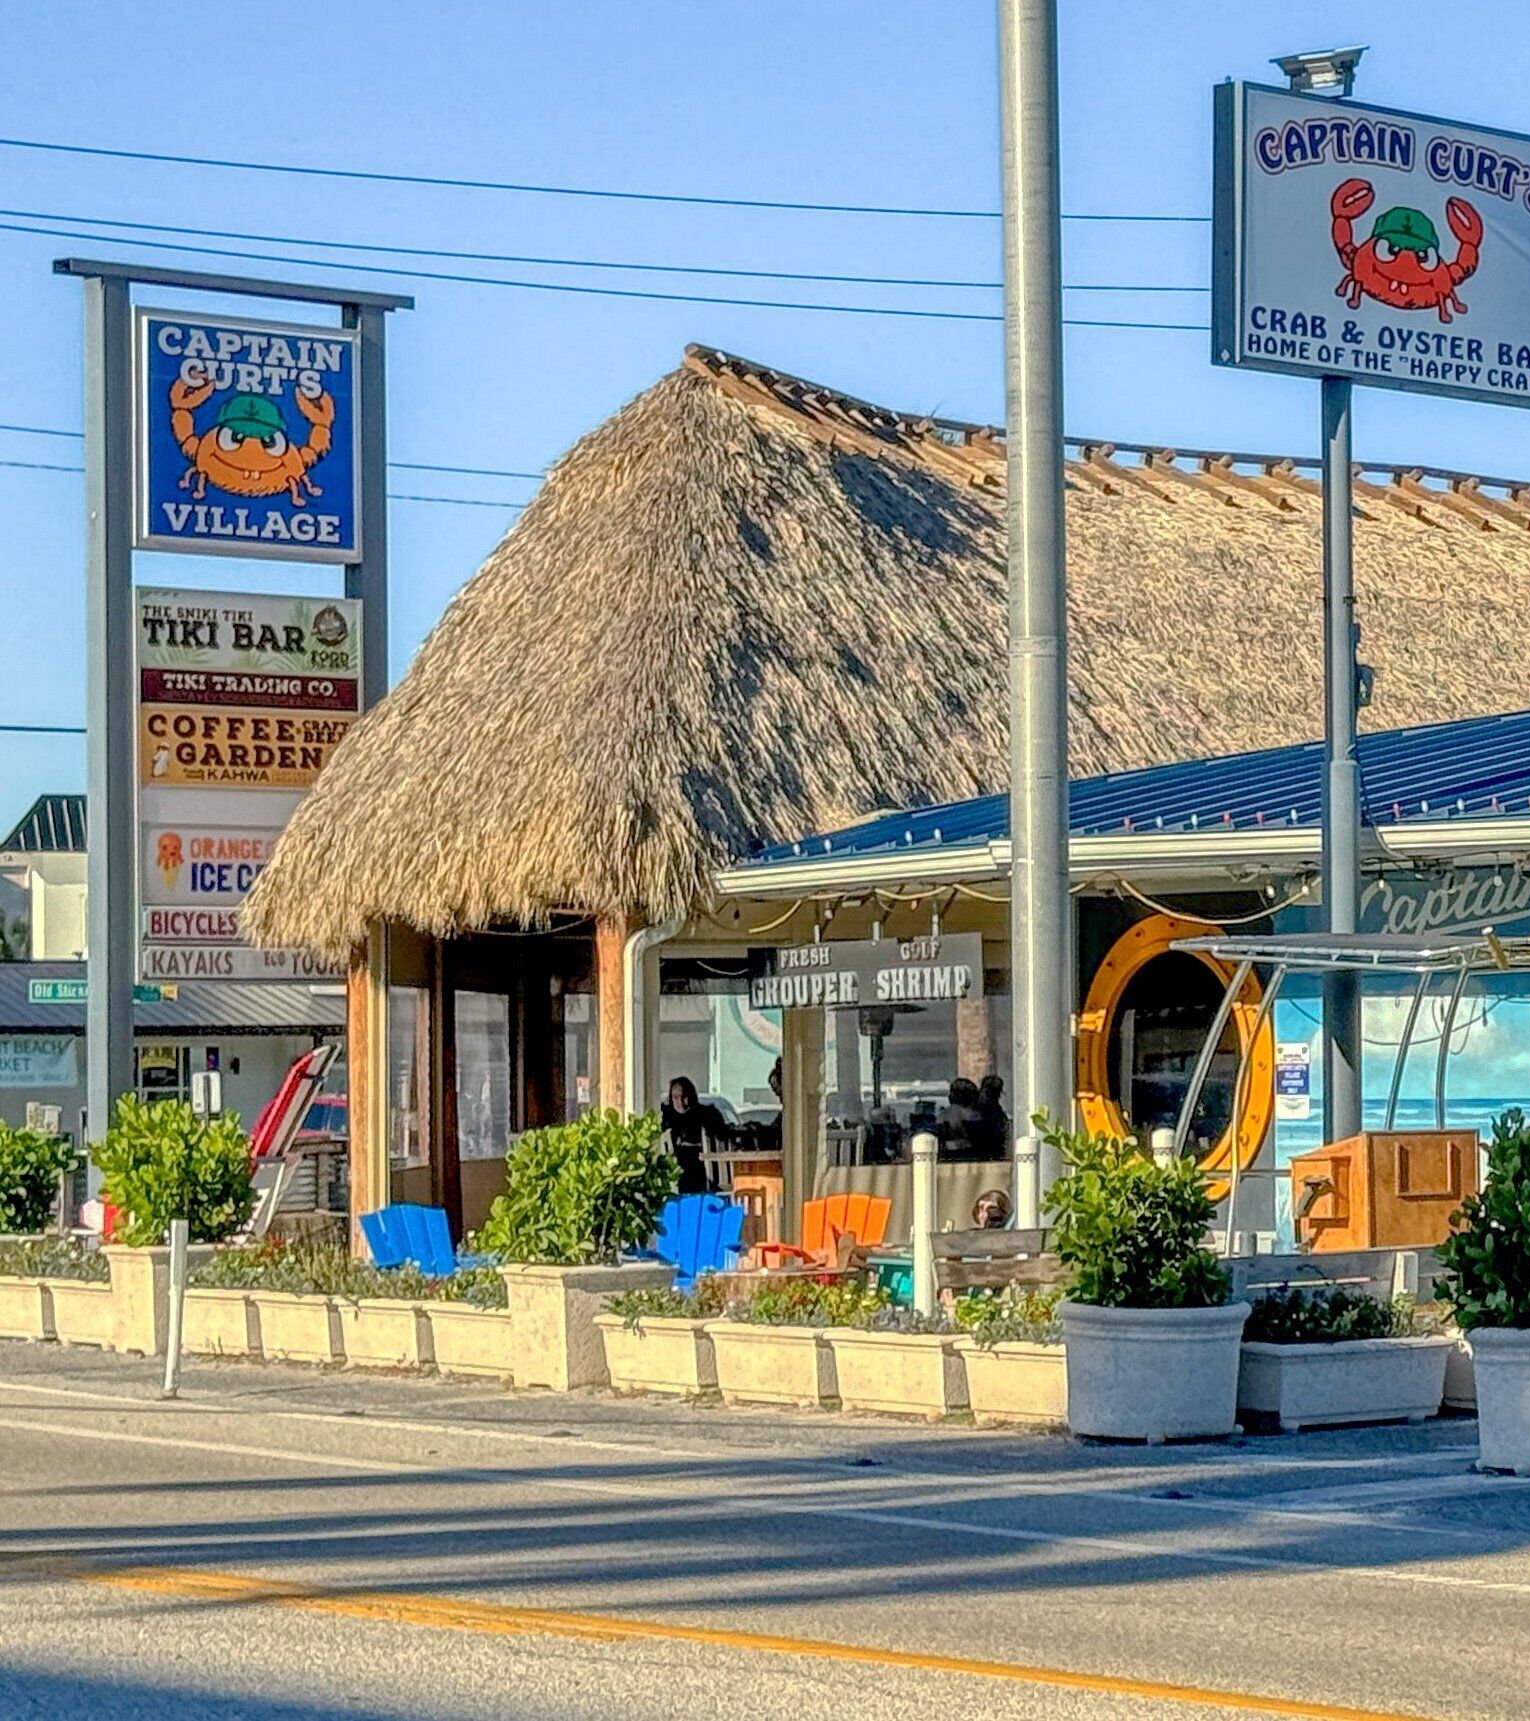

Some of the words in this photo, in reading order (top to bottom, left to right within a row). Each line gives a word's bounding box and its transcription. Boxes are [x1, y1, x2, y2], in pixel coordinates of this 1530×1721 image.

[1257, 119, 1413, 172] CAPTAIN
[1251, 306, 1327, 338] CRAB
[1341, 320, 1364, 344] &
[1378, 326, 1483, 362] OYSTER
[157, 326, 343, 372] CAPTAIN
[1248, 334, 1310, 360] HOME
[1318, 344, 1347, 364] OF
[1351, 349, 1392, 371] THE
[180, 359, 323, 399] CURT'S
[162, 503, 341, 543] VILLAGE
[142, 605, 171, 618] THE
[222, 609, 253, 623] TIKI
[142, 618, 220, 649] TIKI
[232, 623, 306, 653] BAR
[162, 674, 206, 691] TIKI
[211, 675, 301, 695] TRADING
[148, 714, 296, 742] COFFEE
[176, 742, 323, 770] GARDEN
[207, 768, 270, 782] KAHWA
[190, 837, 262, 859] ORANGE
[191, 862, 233, 892] ICE
[150, 911, 238, 936] BICYCLES
[151, 950, 234, 975] KAYAKS
[779, 945, 831, 968] FRESH
[752, 971, 858, 1008] GROUPER
[875, 964, 971, 1000] SHRIMP
[14, 1040, 62, 1055] BEACH
